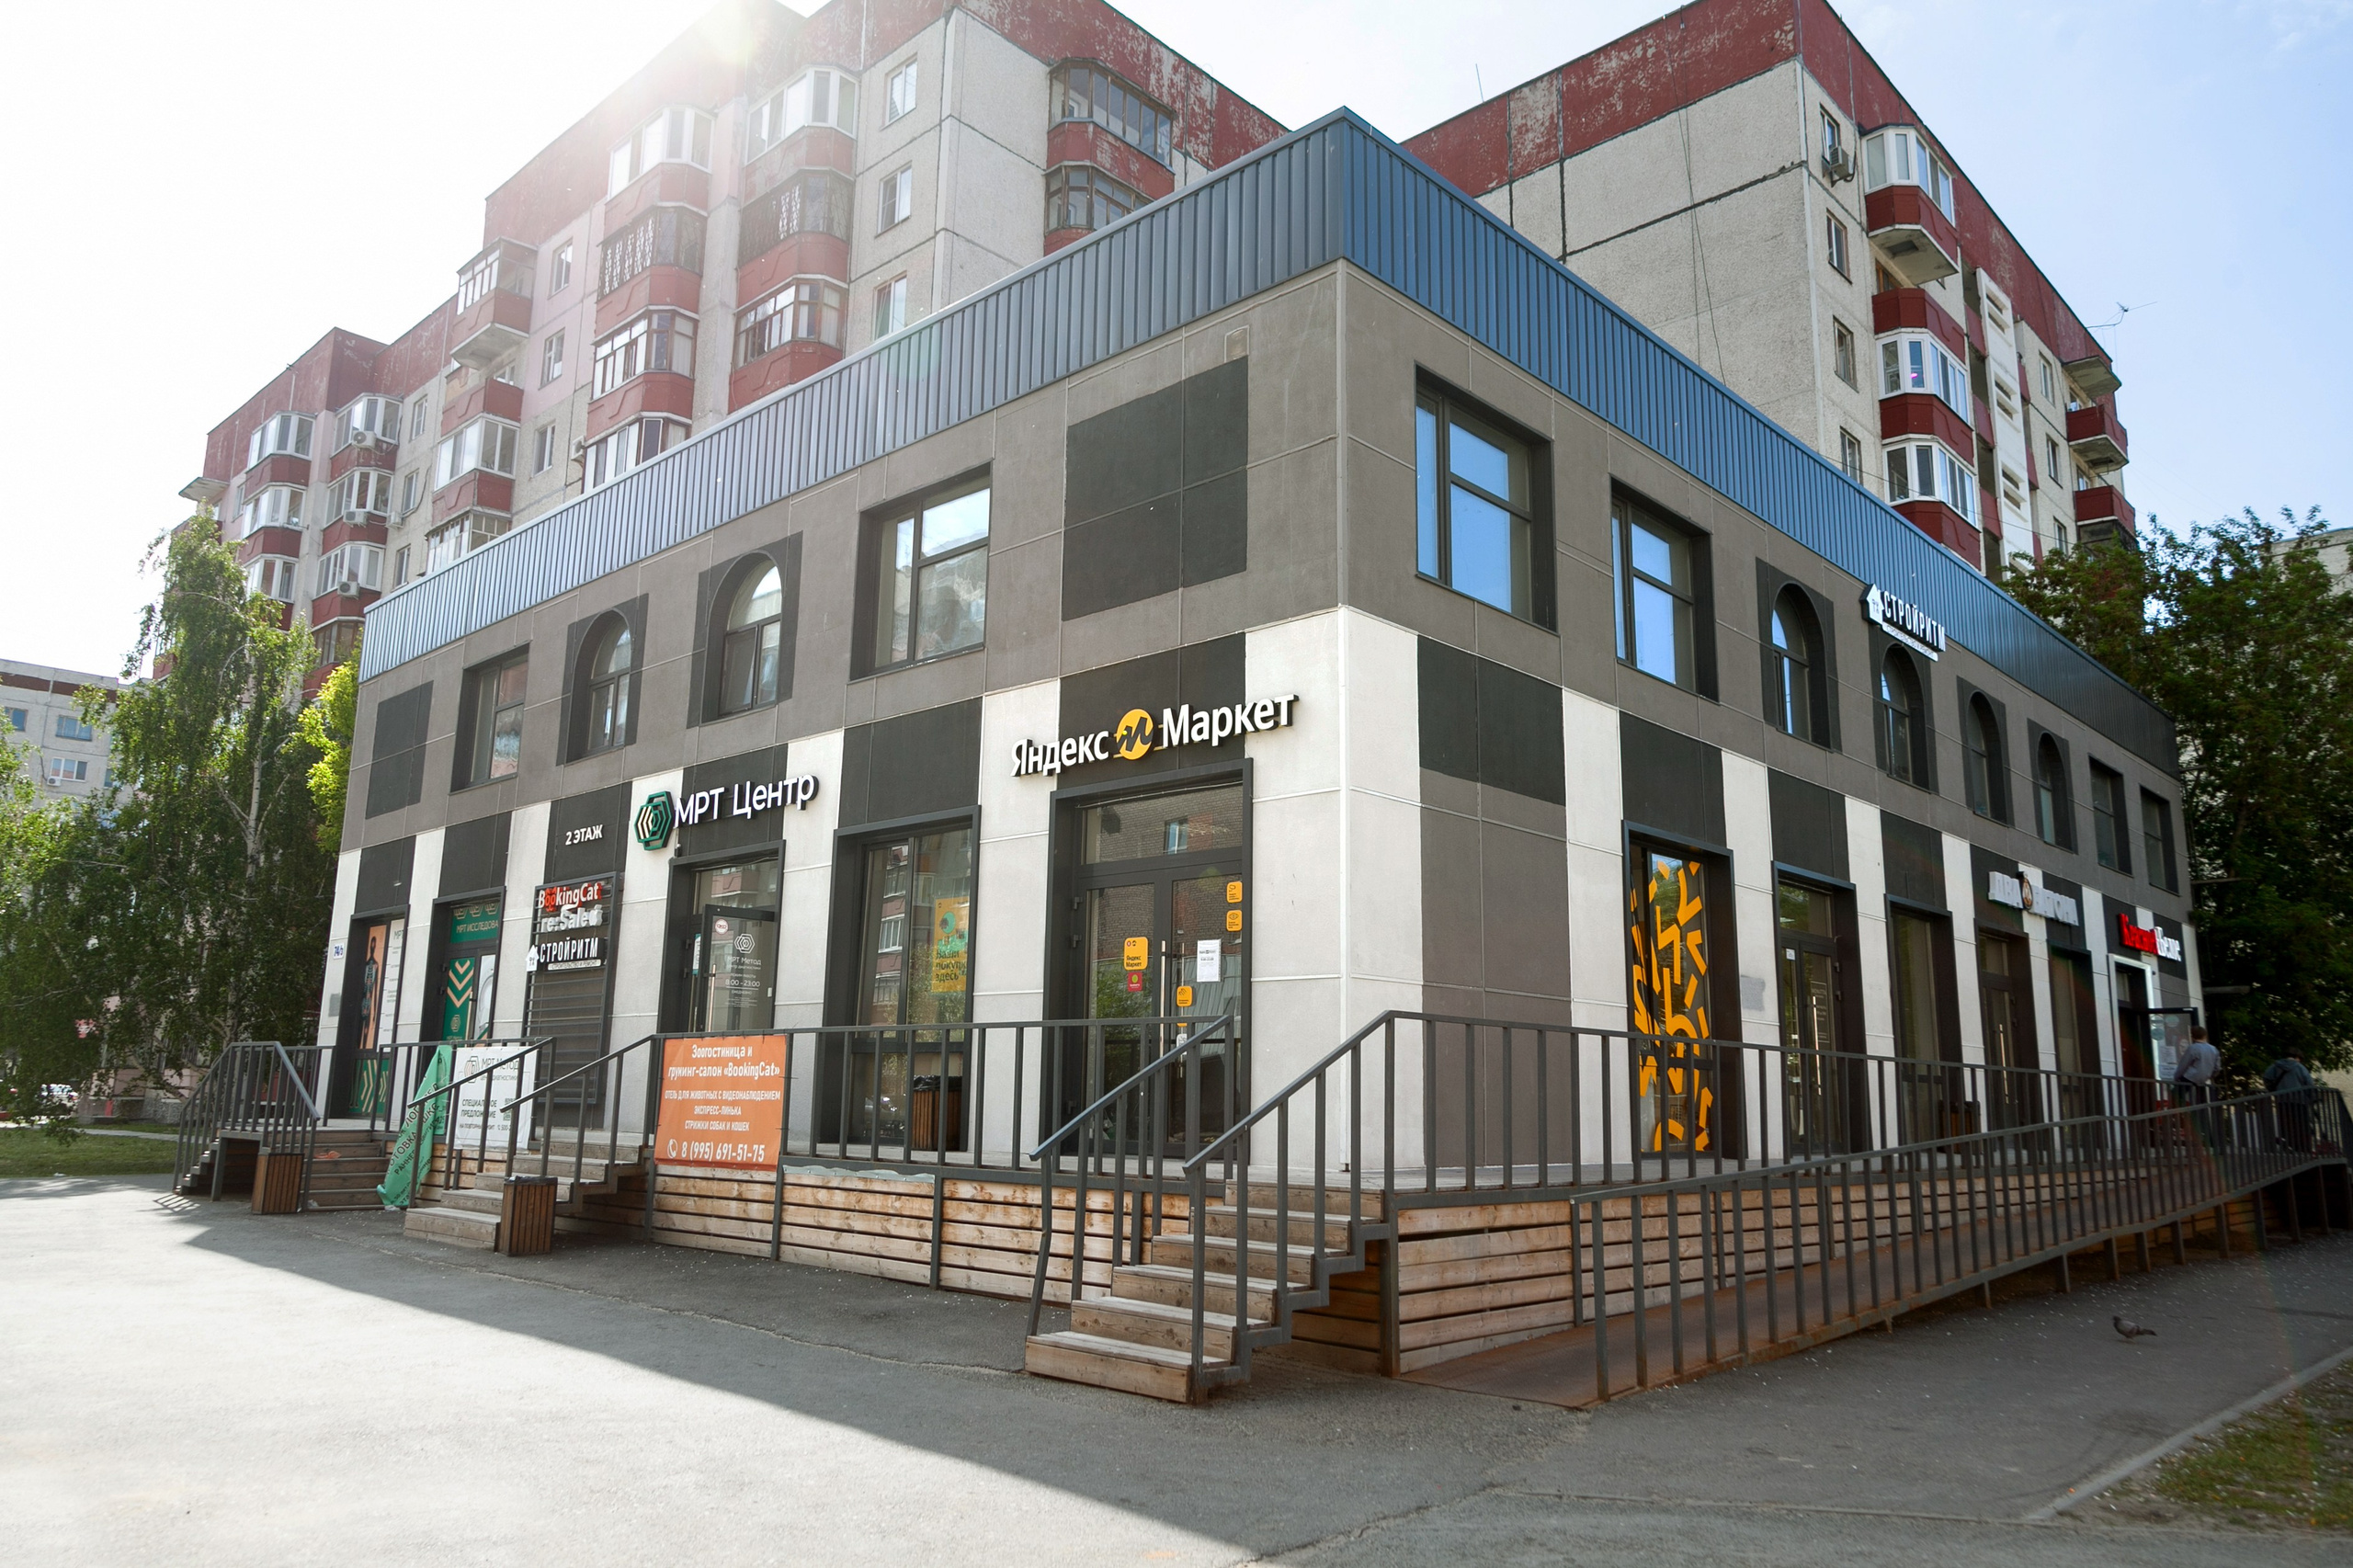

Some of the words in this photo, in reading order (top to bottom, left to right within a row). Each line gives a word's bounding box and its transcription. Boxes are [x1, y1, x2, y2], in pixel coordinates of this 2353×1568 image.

[1883, 590, 1946, 652] СТРОЙРИТМ
[1010, 730, 1109, 777] Яндекс
[1163, 694, 1297, 749] Маркет
[673, 786, 726, 830] МРТ
[733, 774, 816, 820] Центр
[565, 831, 573, 846] 2
[574, 824, 603, 844] ЭТАЖ
[539, 882, 600, 909] BookingCat
[540, 904, 590, 932] re:Sale
[456, 922, 466, 933] МРТ
[540, 937, 599, 963] СТРОЙРИТМ
[741, 957, 762, 966] Метод
[935, 972, 960, 983] здесь
[691, 1044, 745, 1059] Зоогостиница
[747, 1046, 753, 1057] и
[461, 1098, 497, 1108] СПЕЦИАЛОЕ
[665, 1090, 677, 1098] ОТЕЛЬ
[677, 1090, 689, 1100] ДЛЯ
[690, 1091, 718, 1099] ЖИВОТНЫХ
[718, 1091, 722, 1099] С
[722, 1090, 780, 1101] ВИДЕОНАБЛЮДЕНИЕМ
[460, 1109, 496, 1119] ПРЕДЛОЖИЕ
[694, 1106, 742, 1115] ЭКСПРЕСС-ЛИНЬКА
[685, 1120, 709, 1130] СТРИЖКИ
[710, 1121, 725, 1131] СОБАК
[726, 1121, 731, 1131] И
[732, 1121, 750, 1131] КОШЕК
[681, 1142, 688, 1158] 8
[689, 1141, 714, 1162] (995)
[716, 1142, 765, 1163] 691-51-75
[393, 1149, 416, 1176] РАННЕ
